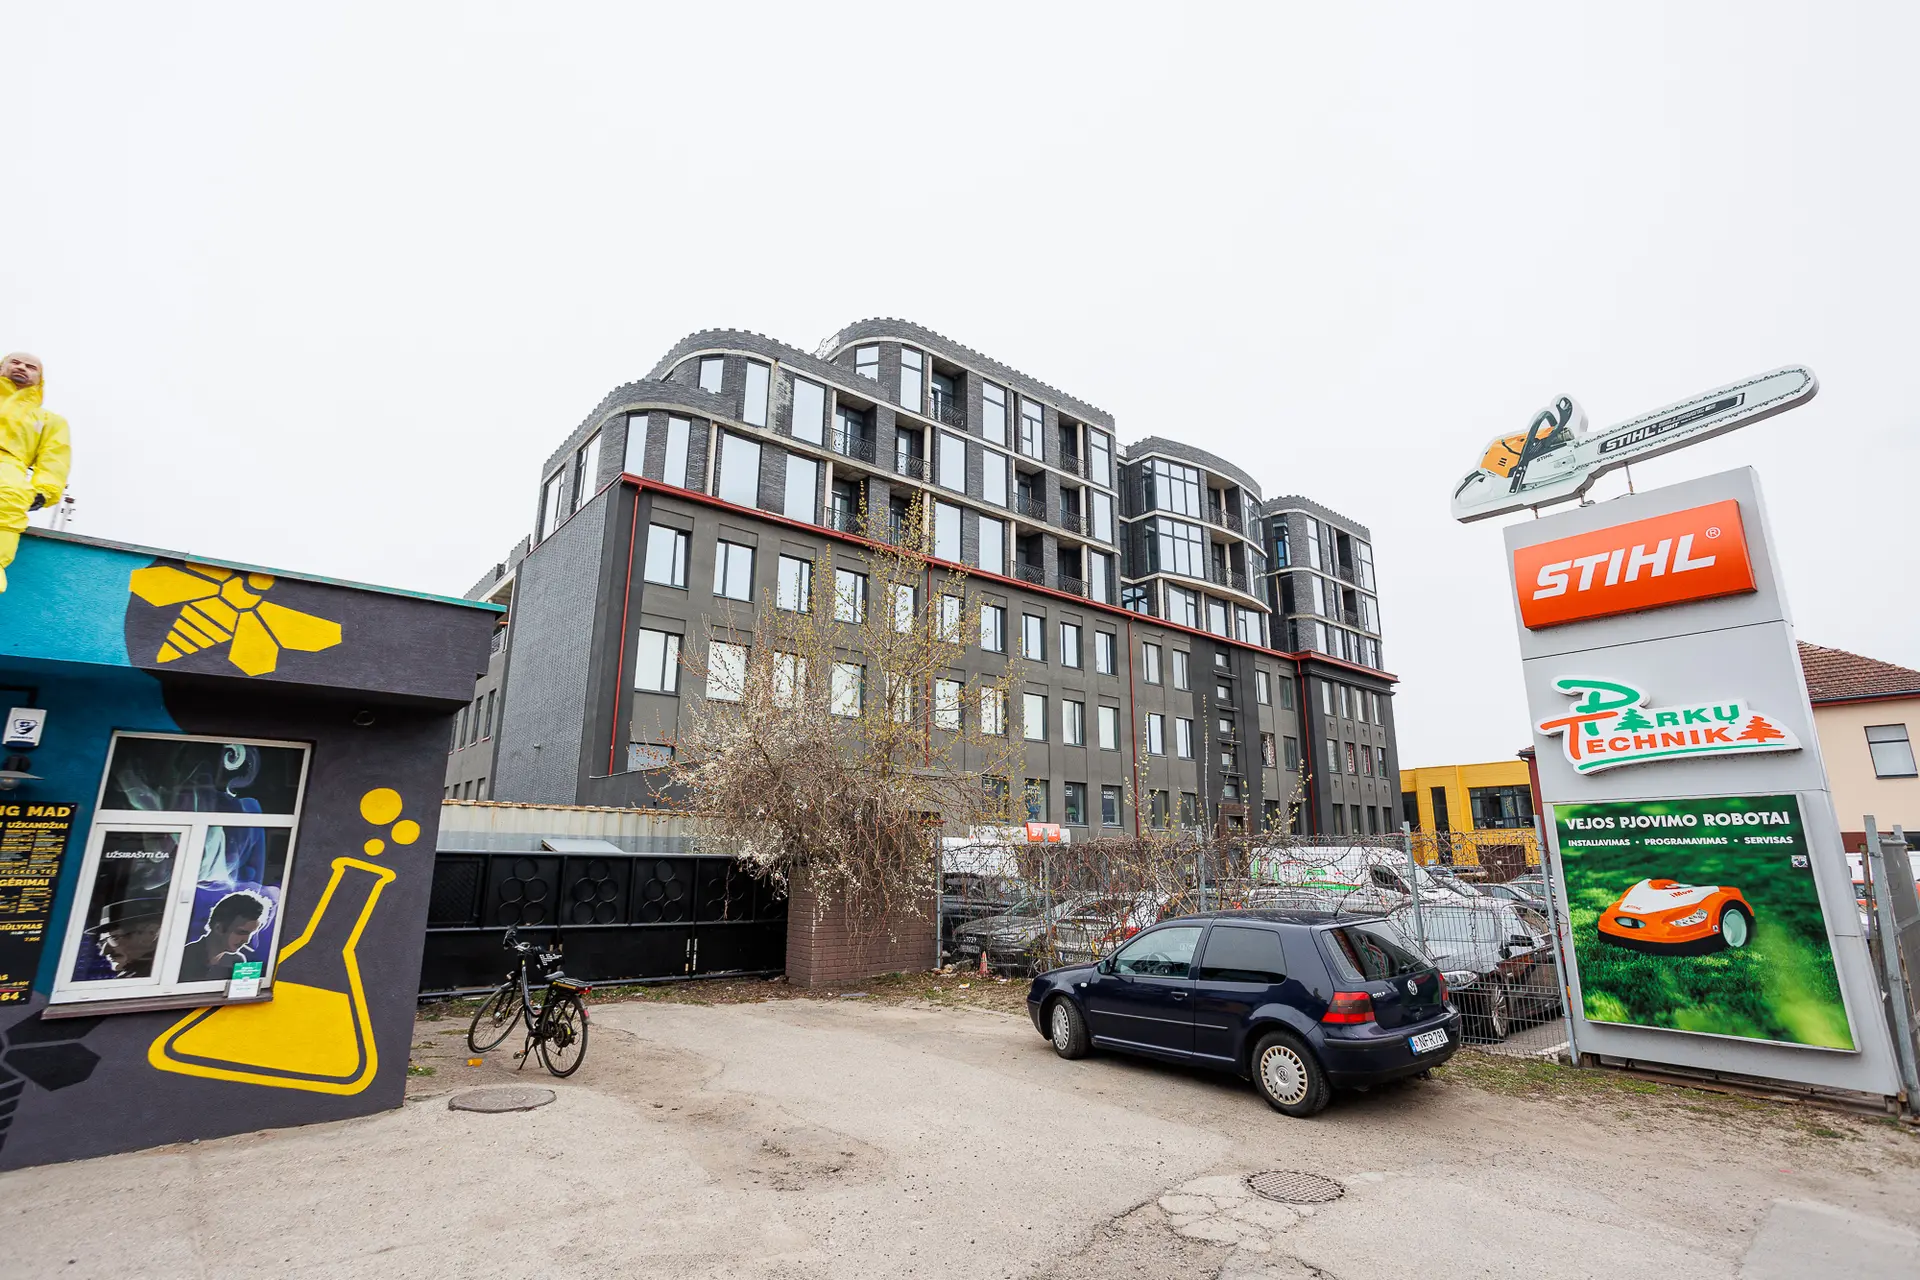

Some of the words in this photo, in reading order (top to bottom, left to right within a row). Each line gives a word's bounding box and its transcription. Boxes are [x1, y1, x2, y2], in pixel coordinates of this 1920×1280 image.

[1658, 422, 1680, 434] LIGHT
[1605, 427, 1656, 452] STIHL
[1536, 453, 1553, 462] STIHL
[1532, 533, 1717, 600] STIHL
[26, 806, 71, 817] MAD
[6, 821, 69, 830] UŽKANDŽIAI
[1565, 817, 1615, 830] VEJOS
[1620, 814, 1697, 829] PJOVIMO
[1703, 811, 1791, 827] ROBOTAI
[1031, 828, 1058, 837] STHL
[1568, 838, 1631, 847] INSTALIAVIMAS
[1644, 836, 1728, 846] PROGRAMAVIMAS
[1744, 836, 1794, 845] SERVISAS
[105, 850, 154, 859] UŽSIRAŠYTI
[155, 850, 170, 859] ČIA
[1418, 1030, 1448, 1048] NFR781
